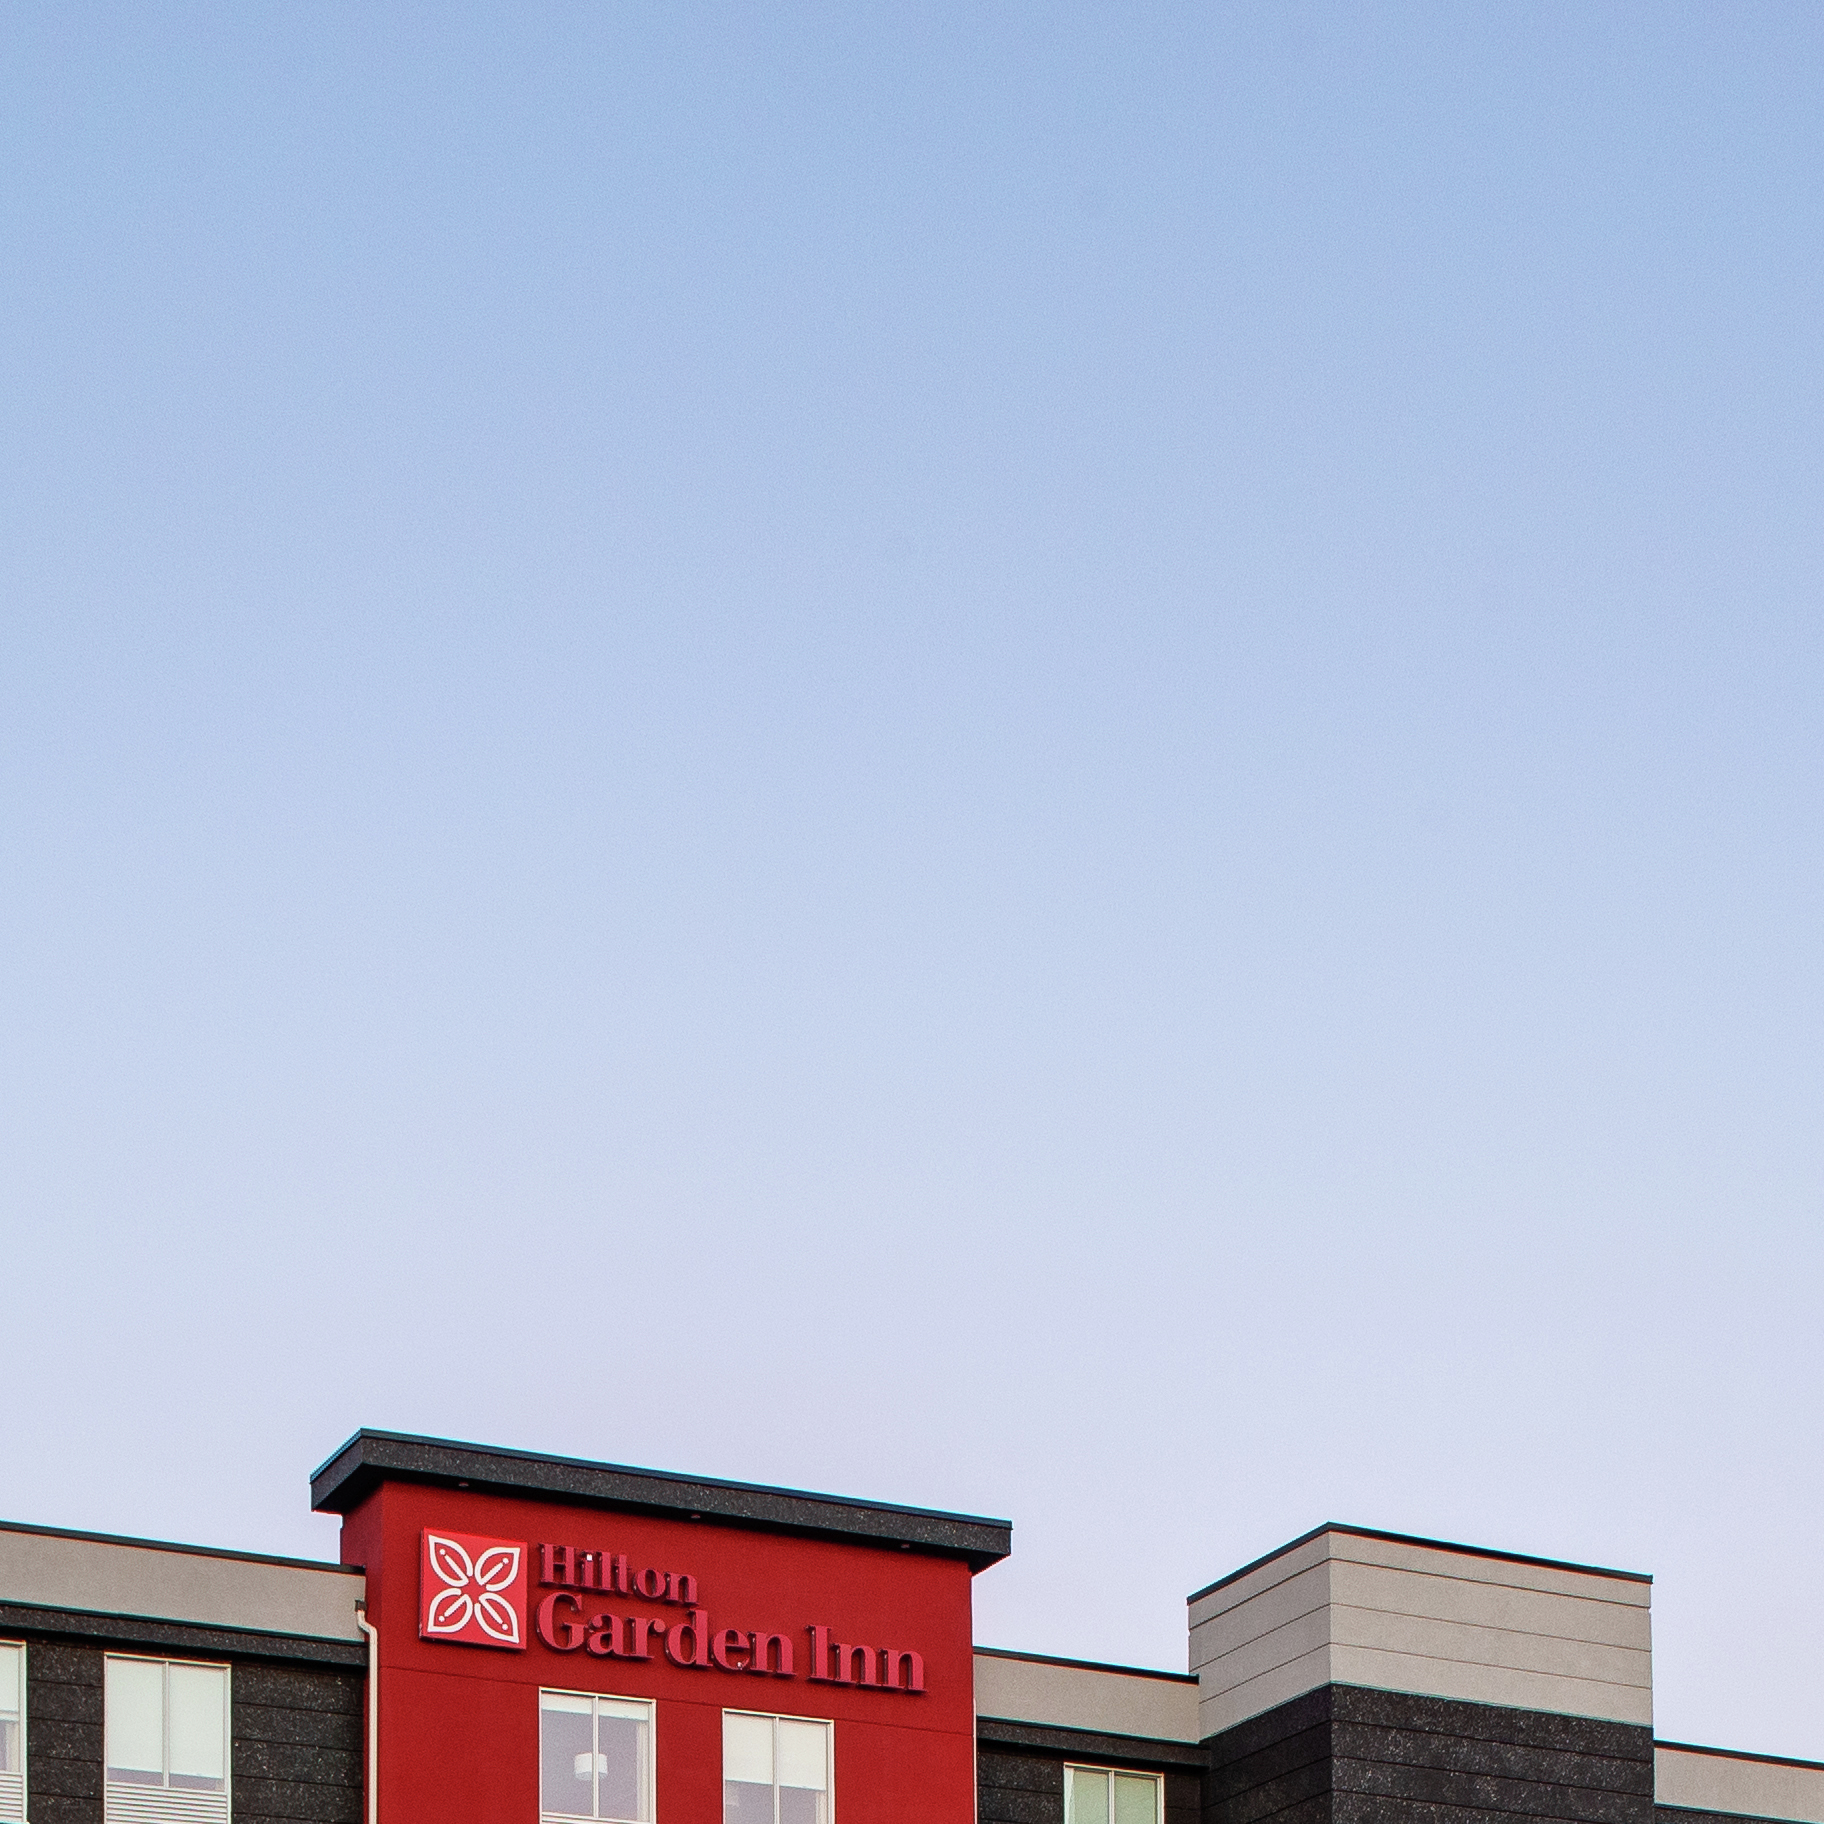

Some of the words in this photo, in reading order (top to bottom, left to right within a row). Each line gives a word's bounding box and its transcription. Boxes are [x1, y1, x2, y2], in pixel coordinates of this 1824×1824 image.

[537, 1542, 698, 1605] Hilton
[535, 1592, 797, 1678] Garden
[804, 1623, 928, 1693] Inn
